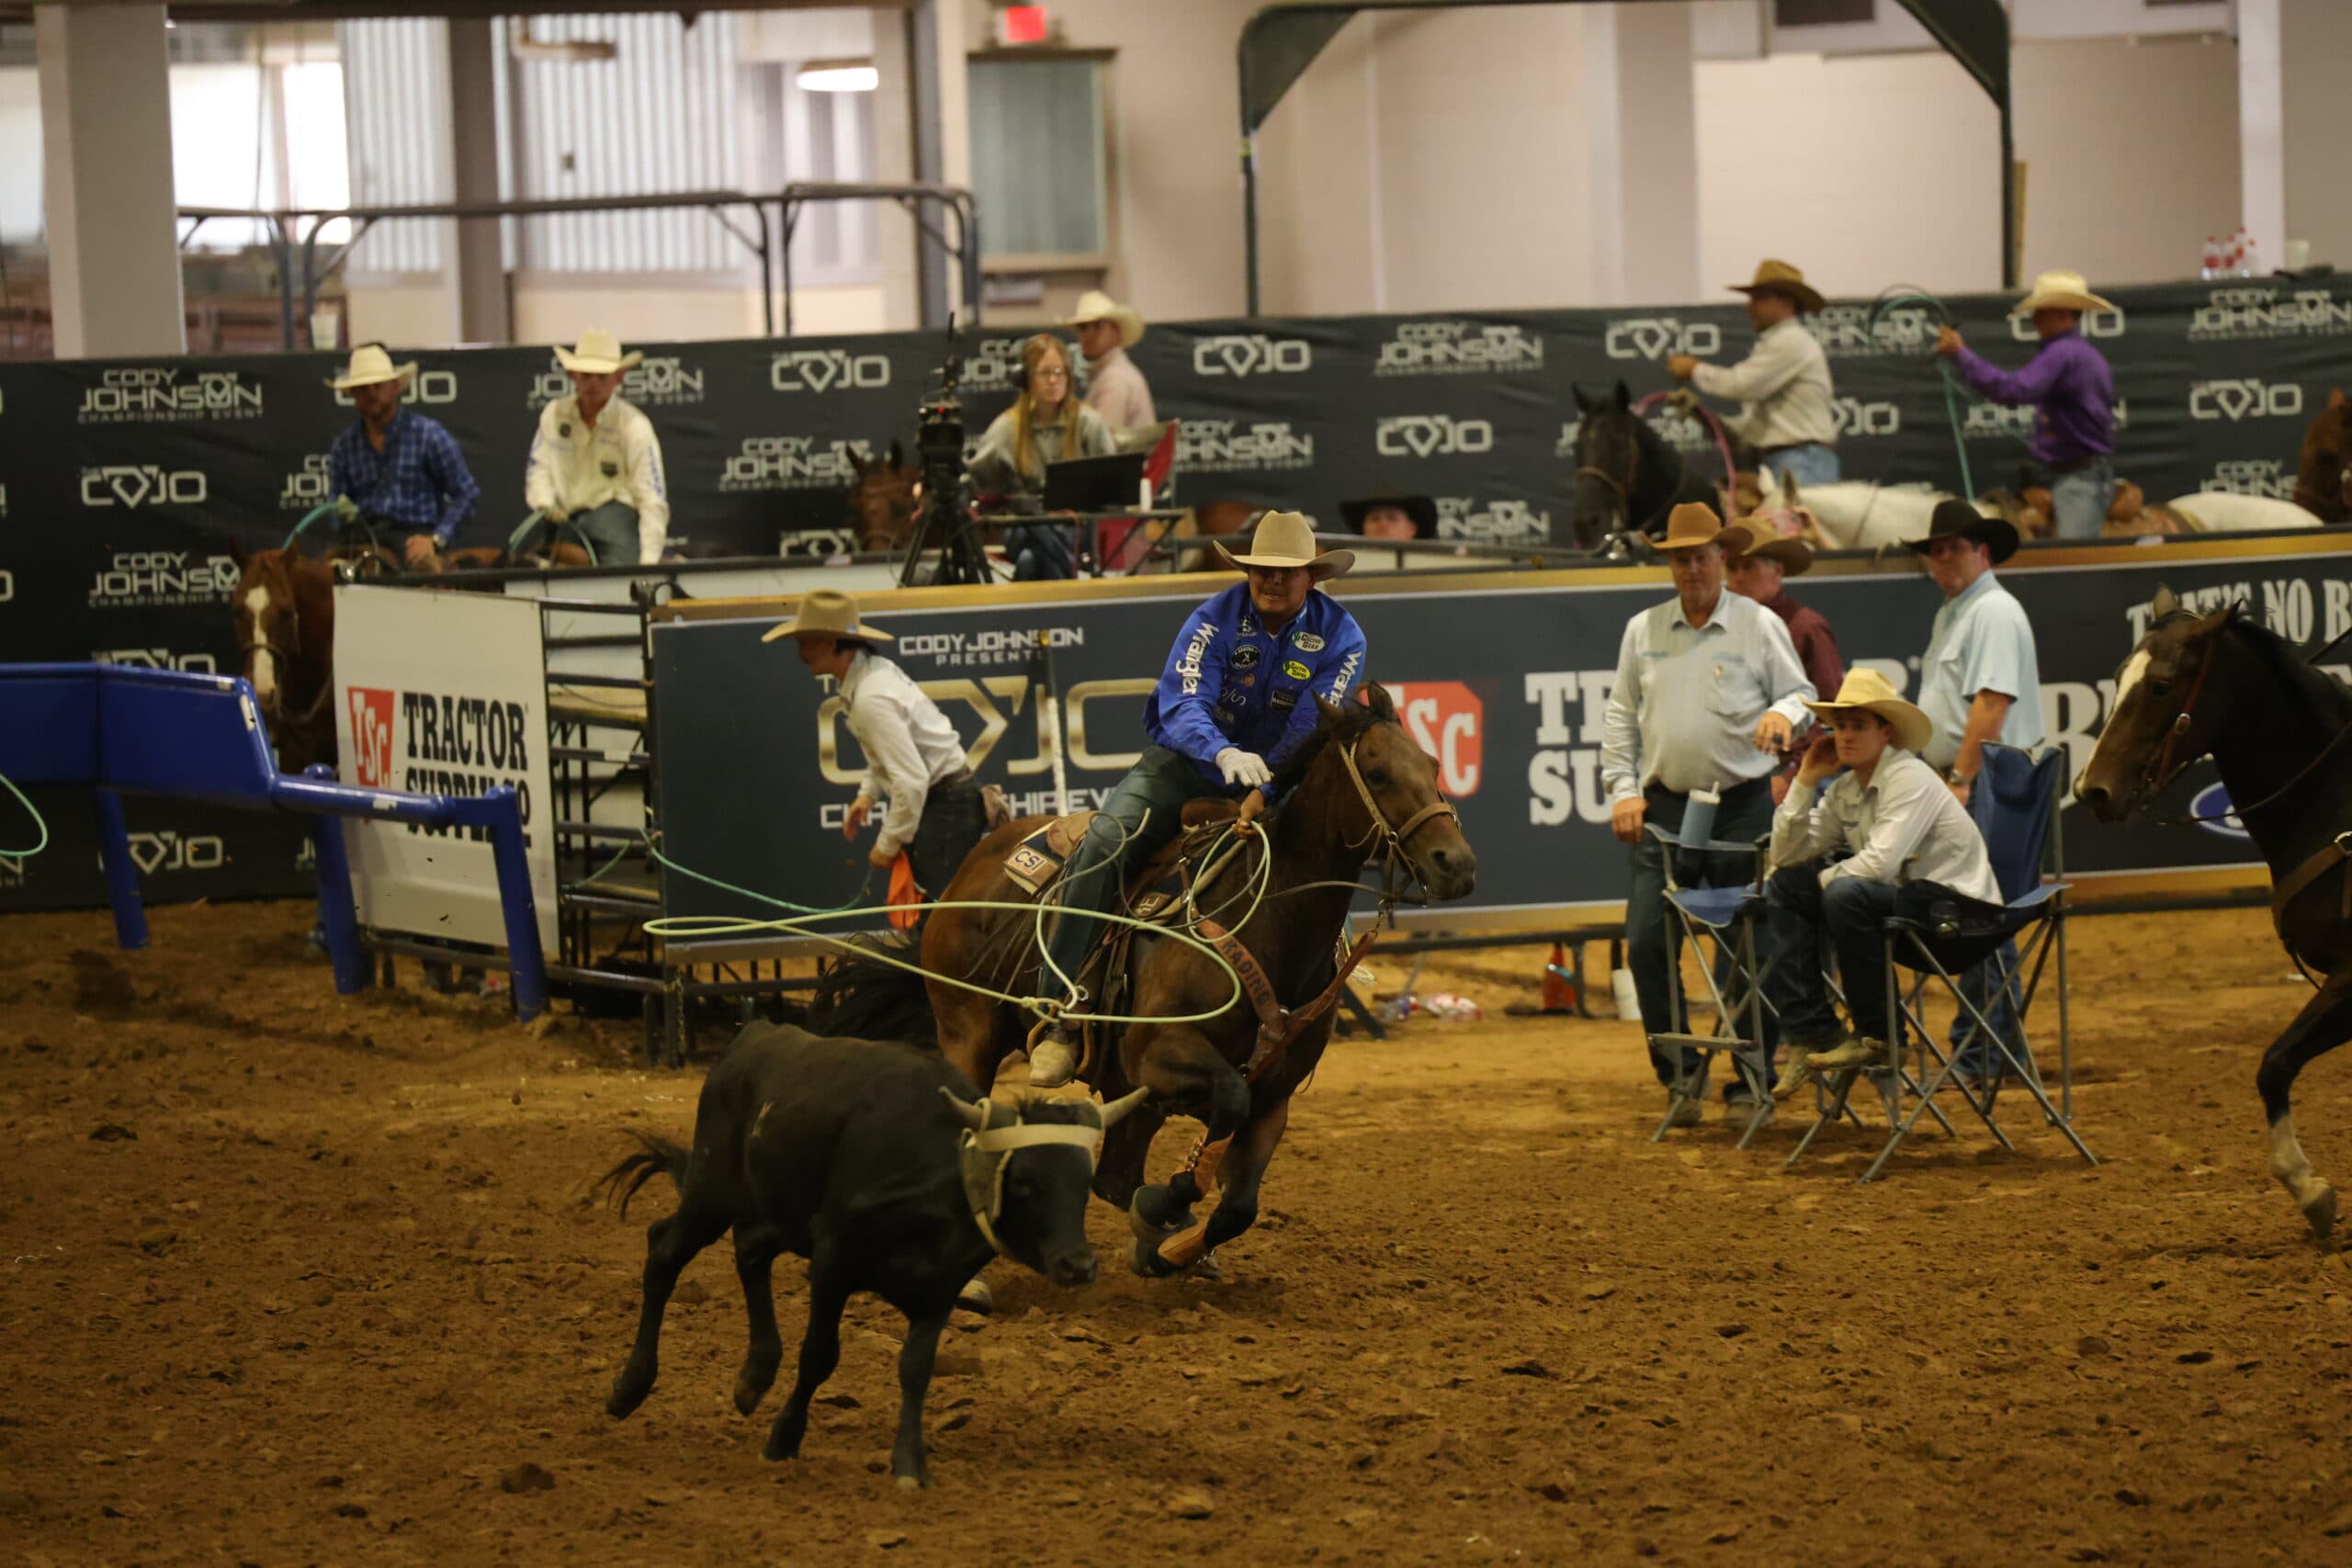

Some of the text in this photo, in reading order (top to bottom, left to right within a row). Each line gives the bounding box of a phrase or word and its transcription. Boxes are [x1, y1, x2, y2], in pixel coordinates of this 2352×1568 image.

[1375, 326, 1544, 367] JOHNSON
[79, 372, 263, 412] JOHNSON
[103, 369, 177, 388] CODY
[742, 436, 813, 457] CODY
[88, 556, 241, 596] JOHNSO
[113, 552, 187, 571] CODY
[2262, 578, 2314, 646] NO
[899, 634, 966, 656] CODY
[1176, 622, 1220, 694] Wrangler
[1320, 651, 1362, 708] Wrang
[401, 692, 528, 772] TRACTOR
[1382, 683, 1477, 795] SC
[1014, 851, 1046, 871] CSI
